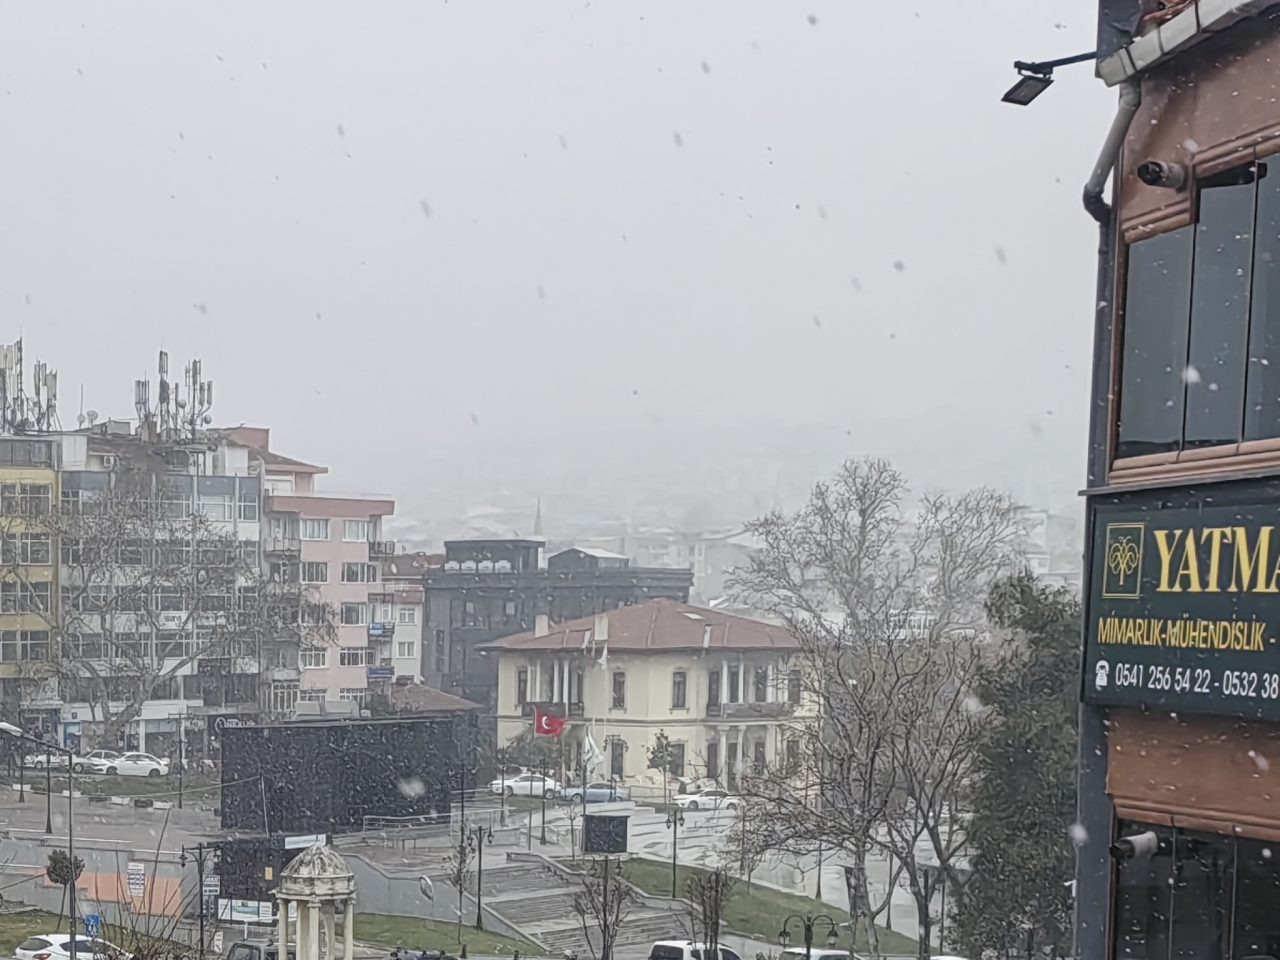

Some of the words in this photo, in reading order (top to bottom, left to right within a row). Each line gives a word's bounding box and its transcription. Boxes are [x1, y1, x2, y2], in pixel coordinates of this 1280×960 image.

[1116, 663, 1143, 687] 0541
[1148, 665, 1171, 690] 256
[1174, 667, 1191, 692] 54
[1194, 669, 1211, 693] 22
[1223, 670, 1258, 697] 0532
[1261, 672, 1279, 699] 38
